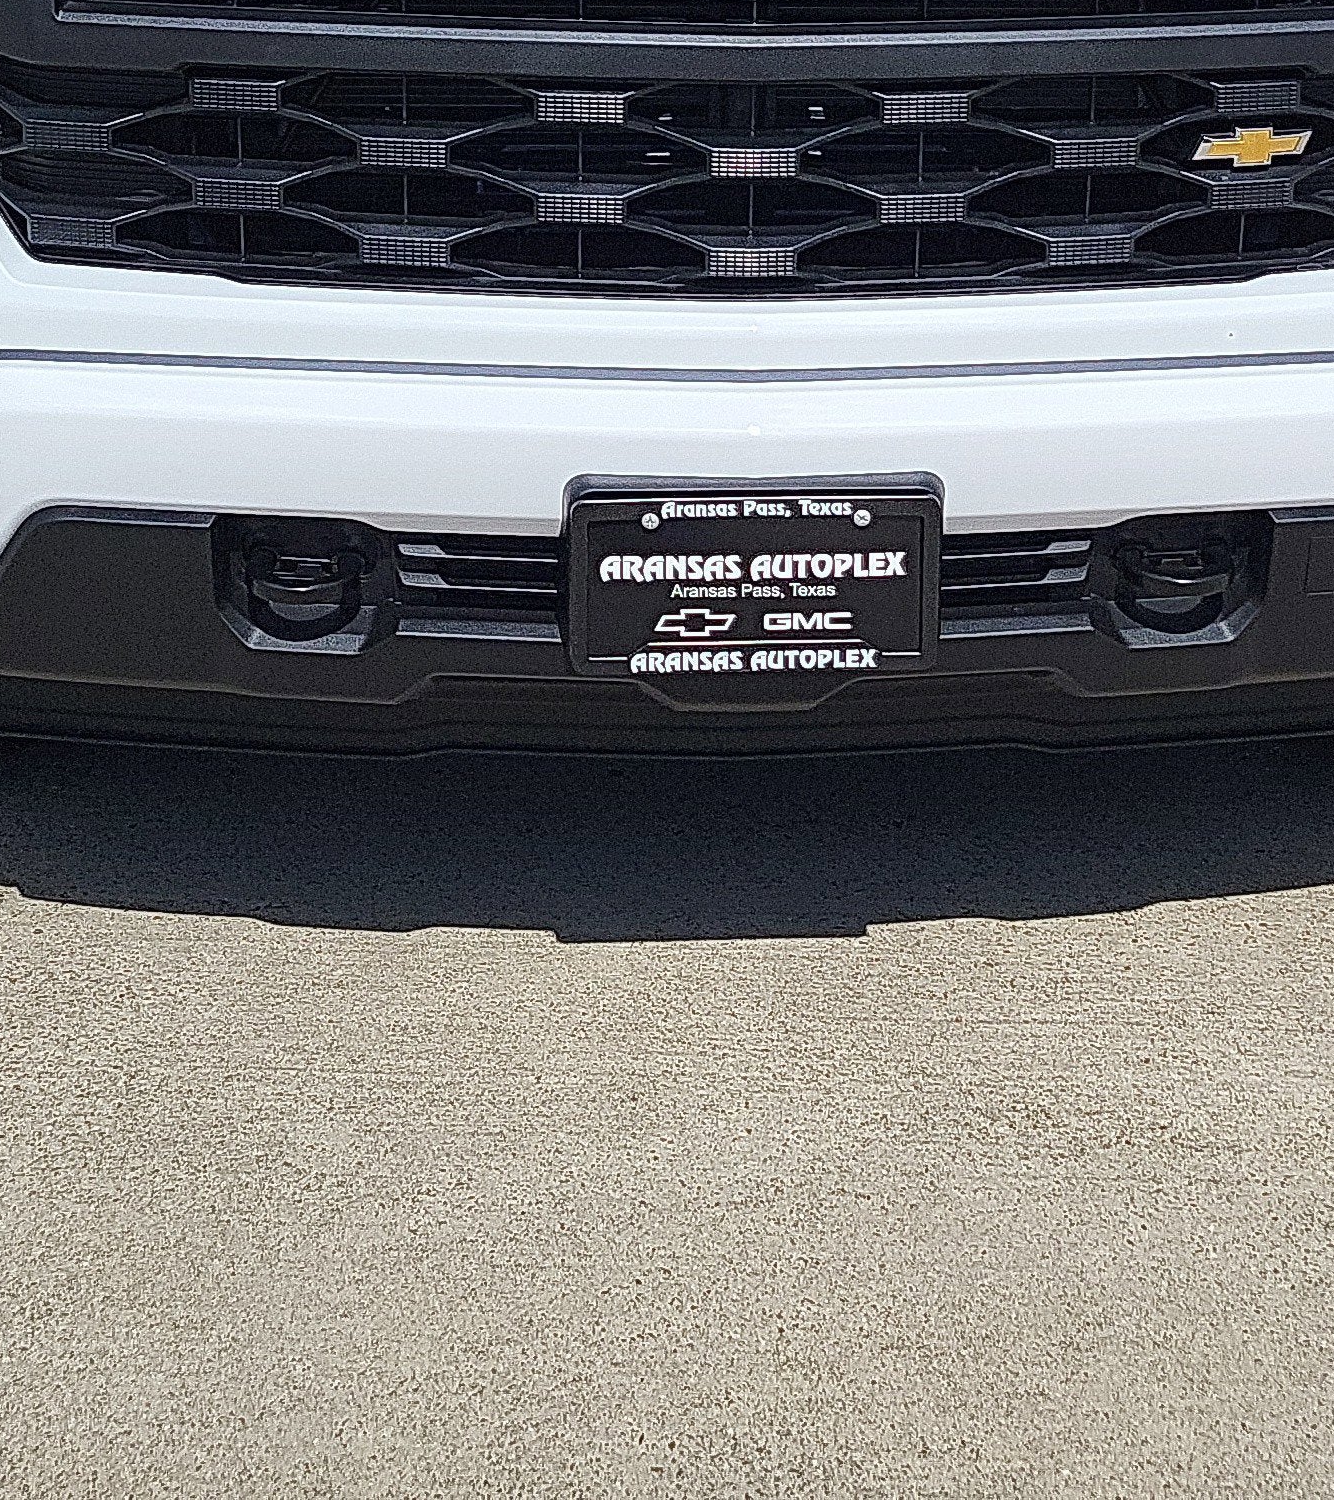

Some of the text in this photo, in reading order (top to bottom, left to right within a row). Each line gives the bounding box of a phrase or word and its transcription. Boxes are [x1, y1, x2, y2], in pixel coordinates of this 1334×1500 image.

[661, 500, 853, 519] Aransas Pass, Texas
[599, 551, 908, 583] ARANSAS AUTOPLEX
[670, 583, 836, 599] Aransas Pass, Texas
[763, 611, 854, 631] GMC
[630, 647, 879, 674] ARANSAS AUTOPLEX
